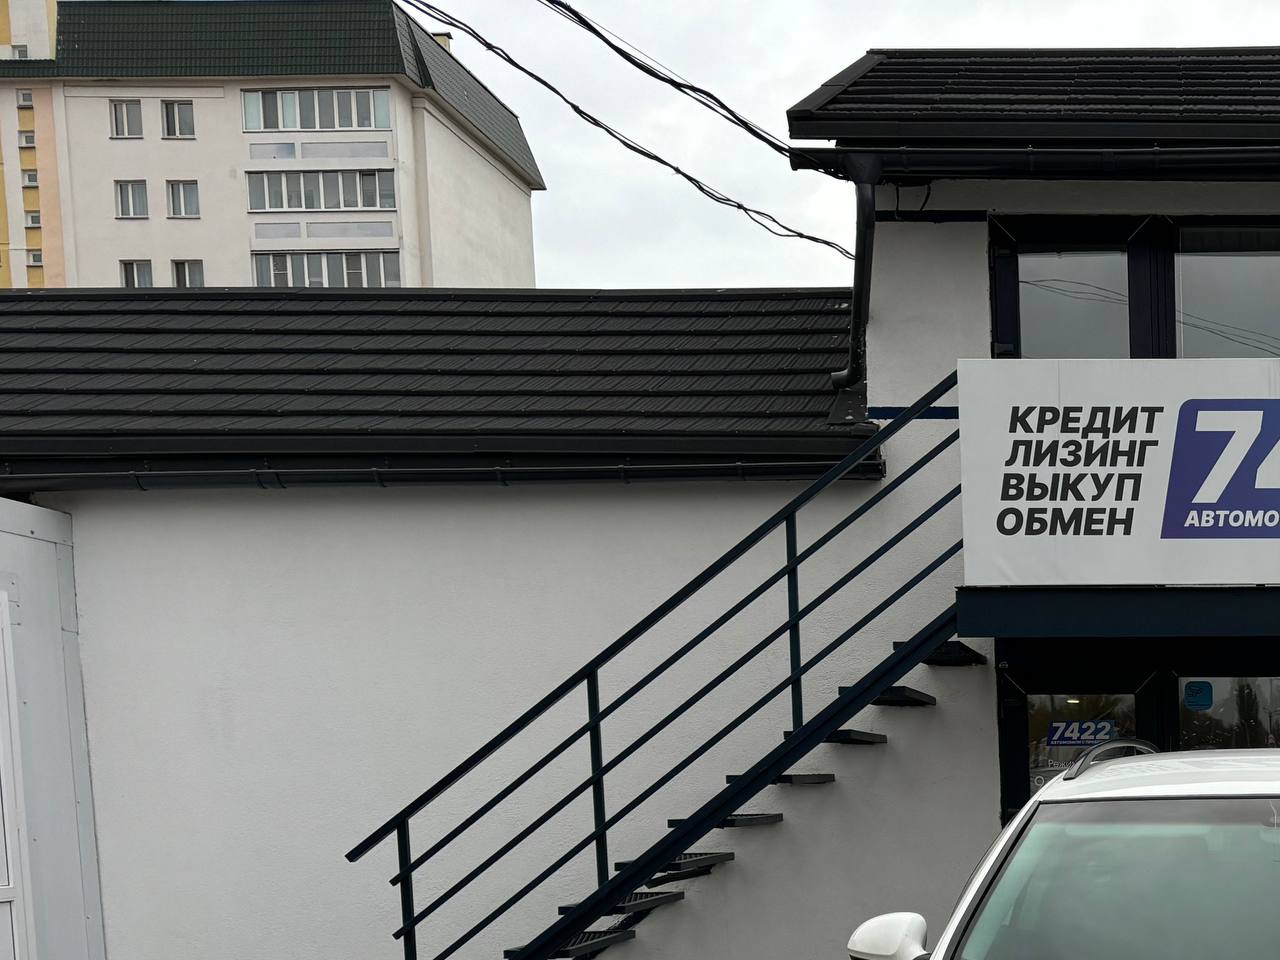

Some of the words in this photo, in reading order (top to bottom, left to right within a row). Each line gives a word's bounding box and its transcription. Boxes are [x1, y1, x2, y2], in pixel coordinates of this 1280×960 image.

[1008, 406, 1163, 440] КРЕДИТ
[1005, 439, 1159, 467] ЛИЗИНГ
[1000, 473, 1142, 502] ВЫКУП
[996, 507, 1134, 536] ОБМЕН
[1052, 722, 1111, 740] 7422
